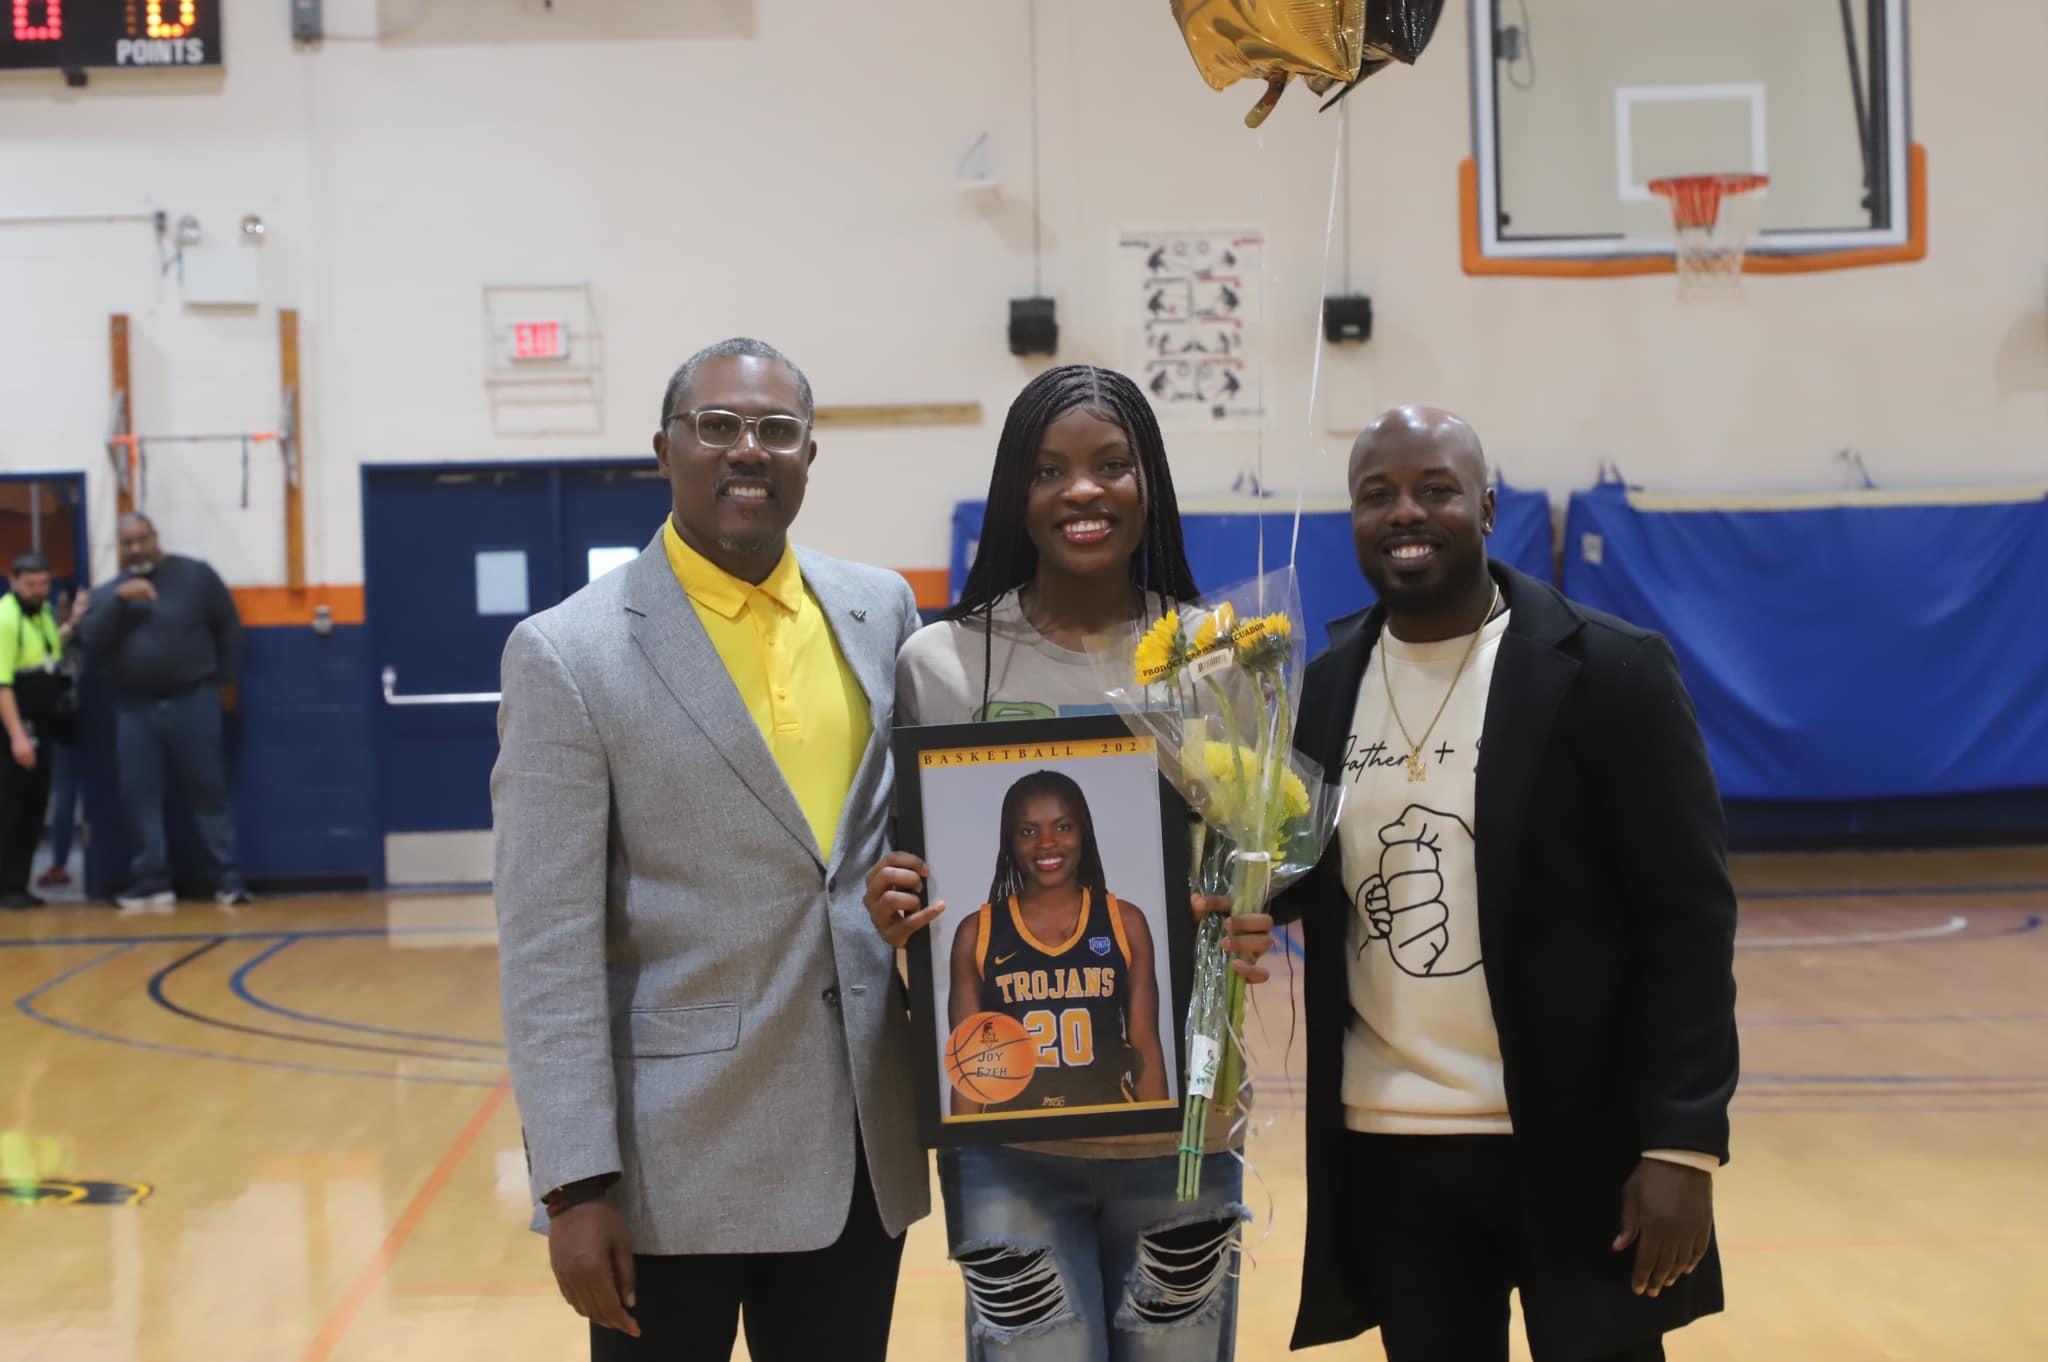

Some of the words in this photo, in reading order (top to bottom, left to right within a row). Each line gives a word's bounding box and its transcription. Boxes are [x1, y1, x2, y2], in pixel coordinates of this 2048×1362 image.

[116, 39, 203, 64] POINTS
[514, 320, 560, 359] EXIT
[1229, 621, 1265, 642] CUADOR
[924, 746, 1073, 765] BASKETBALL
[1102, 741, 1152, 753] 202
[996, 967, 1115, 1004] TROJANS
[1023, 1008, 1095, 1067] 20
[978, 1051, 1004, 1062] JOY
